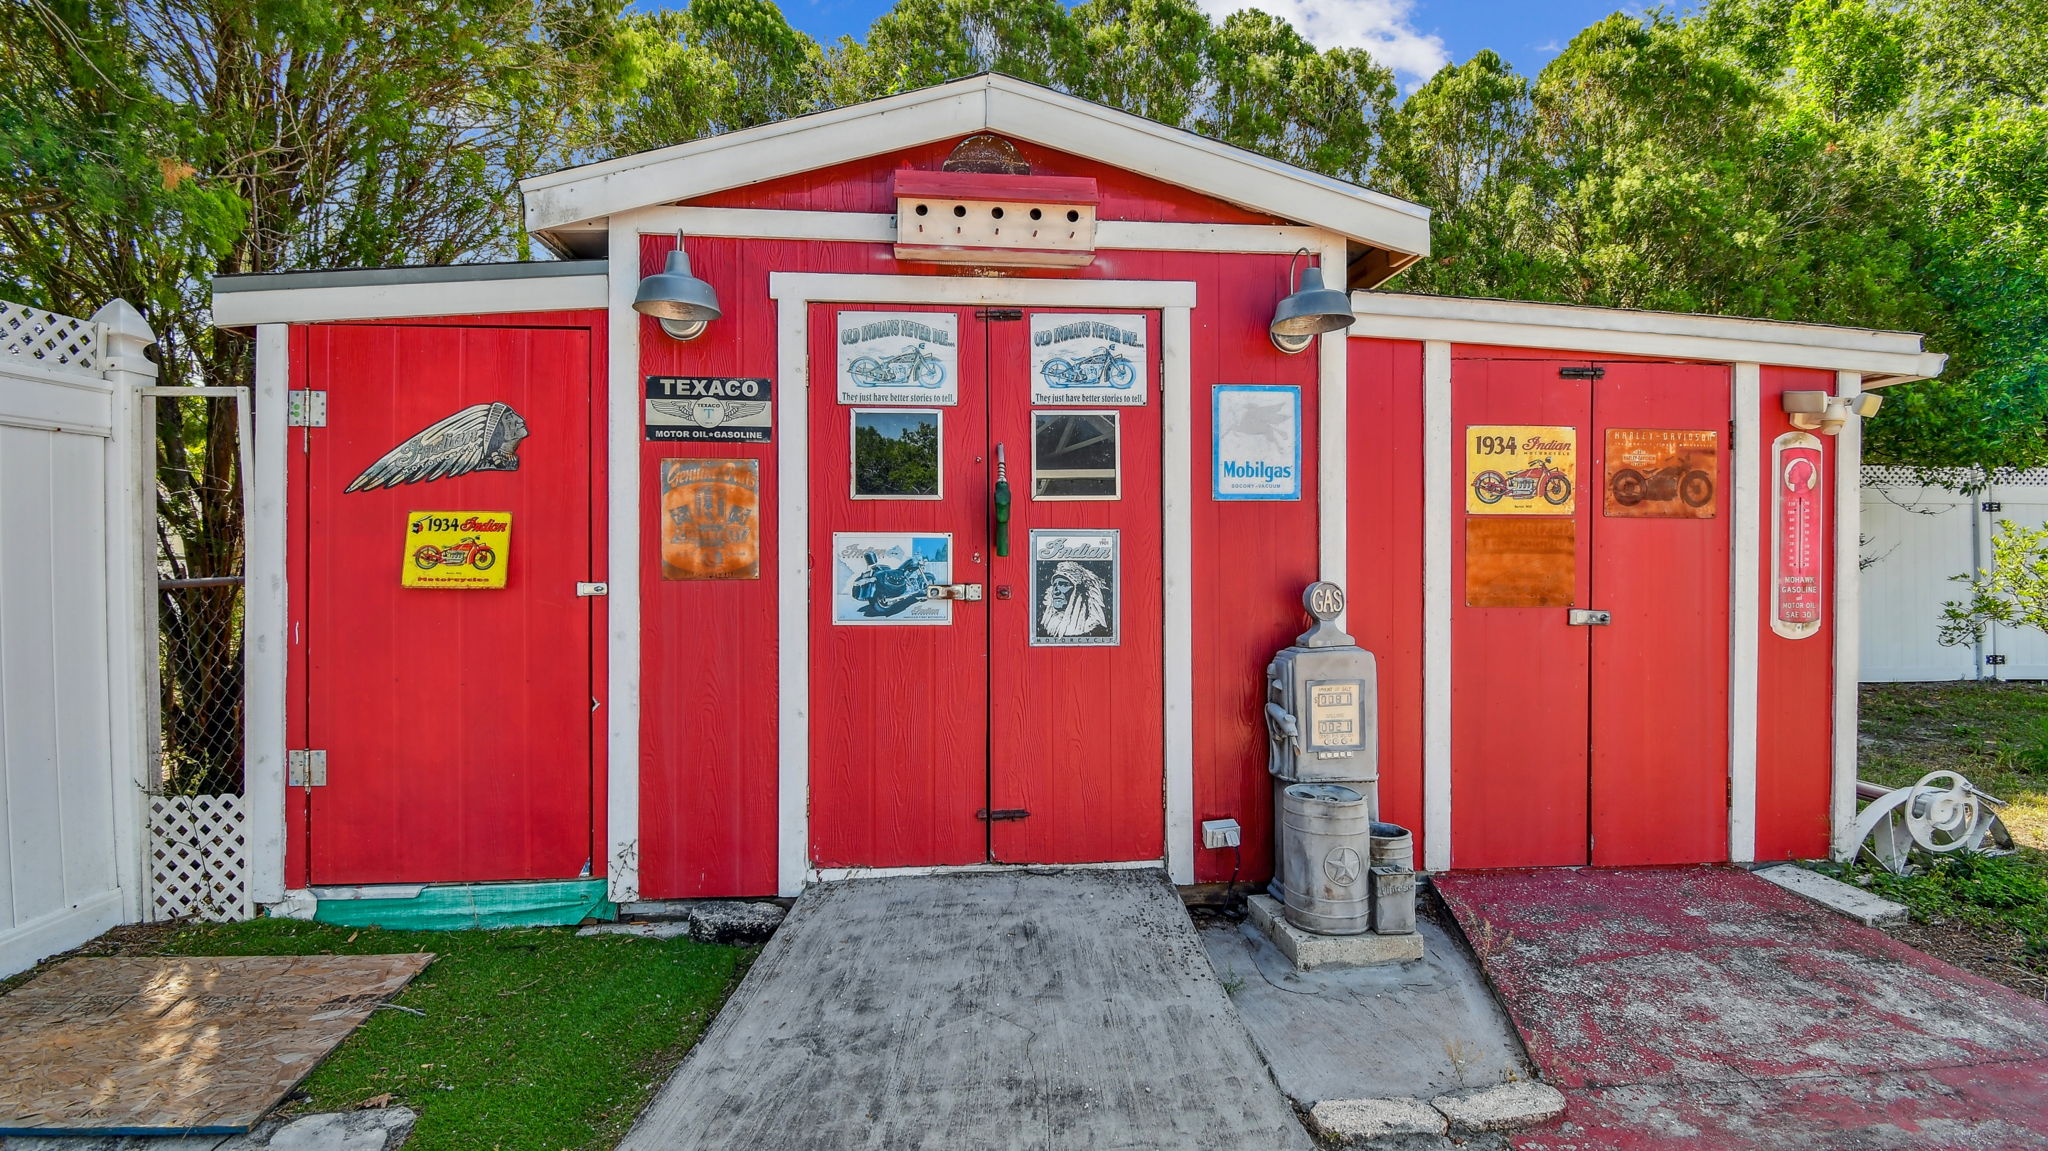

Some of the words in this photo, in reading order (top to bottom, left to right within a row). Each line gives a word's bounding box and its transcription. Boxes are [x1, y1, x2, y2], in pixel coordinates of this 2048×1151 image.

[842, 328, 860, 345] OLD
[861, 319, 900, 342] INDIANS
[901, 320, 931, 343] NEVER
[1034, 329, 1052, 347] OLD
[1054, 320, 1091, 343] INDIANS
[1092, 321, 1120, 344] NEVER
[660, 379, 759, 397] TEXACO
[842, 392, 858, 402] They
[859, 392, 872, 403] just
[873, 393, 889, 402] have
[890, 393, 909, 402] better
[911, 393, 932, 402] stories
[934, 394, 941, 402] to
[1036, 393, 1051, 403] They
[1052, 393, 1064, 403] just
[1065, 393, 1080, 402] have
[1082, 393, 1100, 403] better
[1102, 394, 1123, 403] stories
[1124, 395, 1131, 403] to
[703, 408, 714, 419] T
[655, 430, 690, 438] MOTOR
[714, 431, 763, 439] GASOLINE
[1614, 431, 1713, 442] HARLEY-DAVIDSON
[395, 428, 480, 469] Indian
[1475, 435, 1517, 455] 1934
[1522, 436, 1572, 451] Indian
[402, 441, 482, 475] MOTORCYCLE
[1223, 460, 1292, 483] Mobilgas
[428, 518, 459, 532] 1934
[459, 516, 507, 532] Indian
[1039, 538, 1111, 560] Indian
[1312, 589, 1343, 613] GAS
